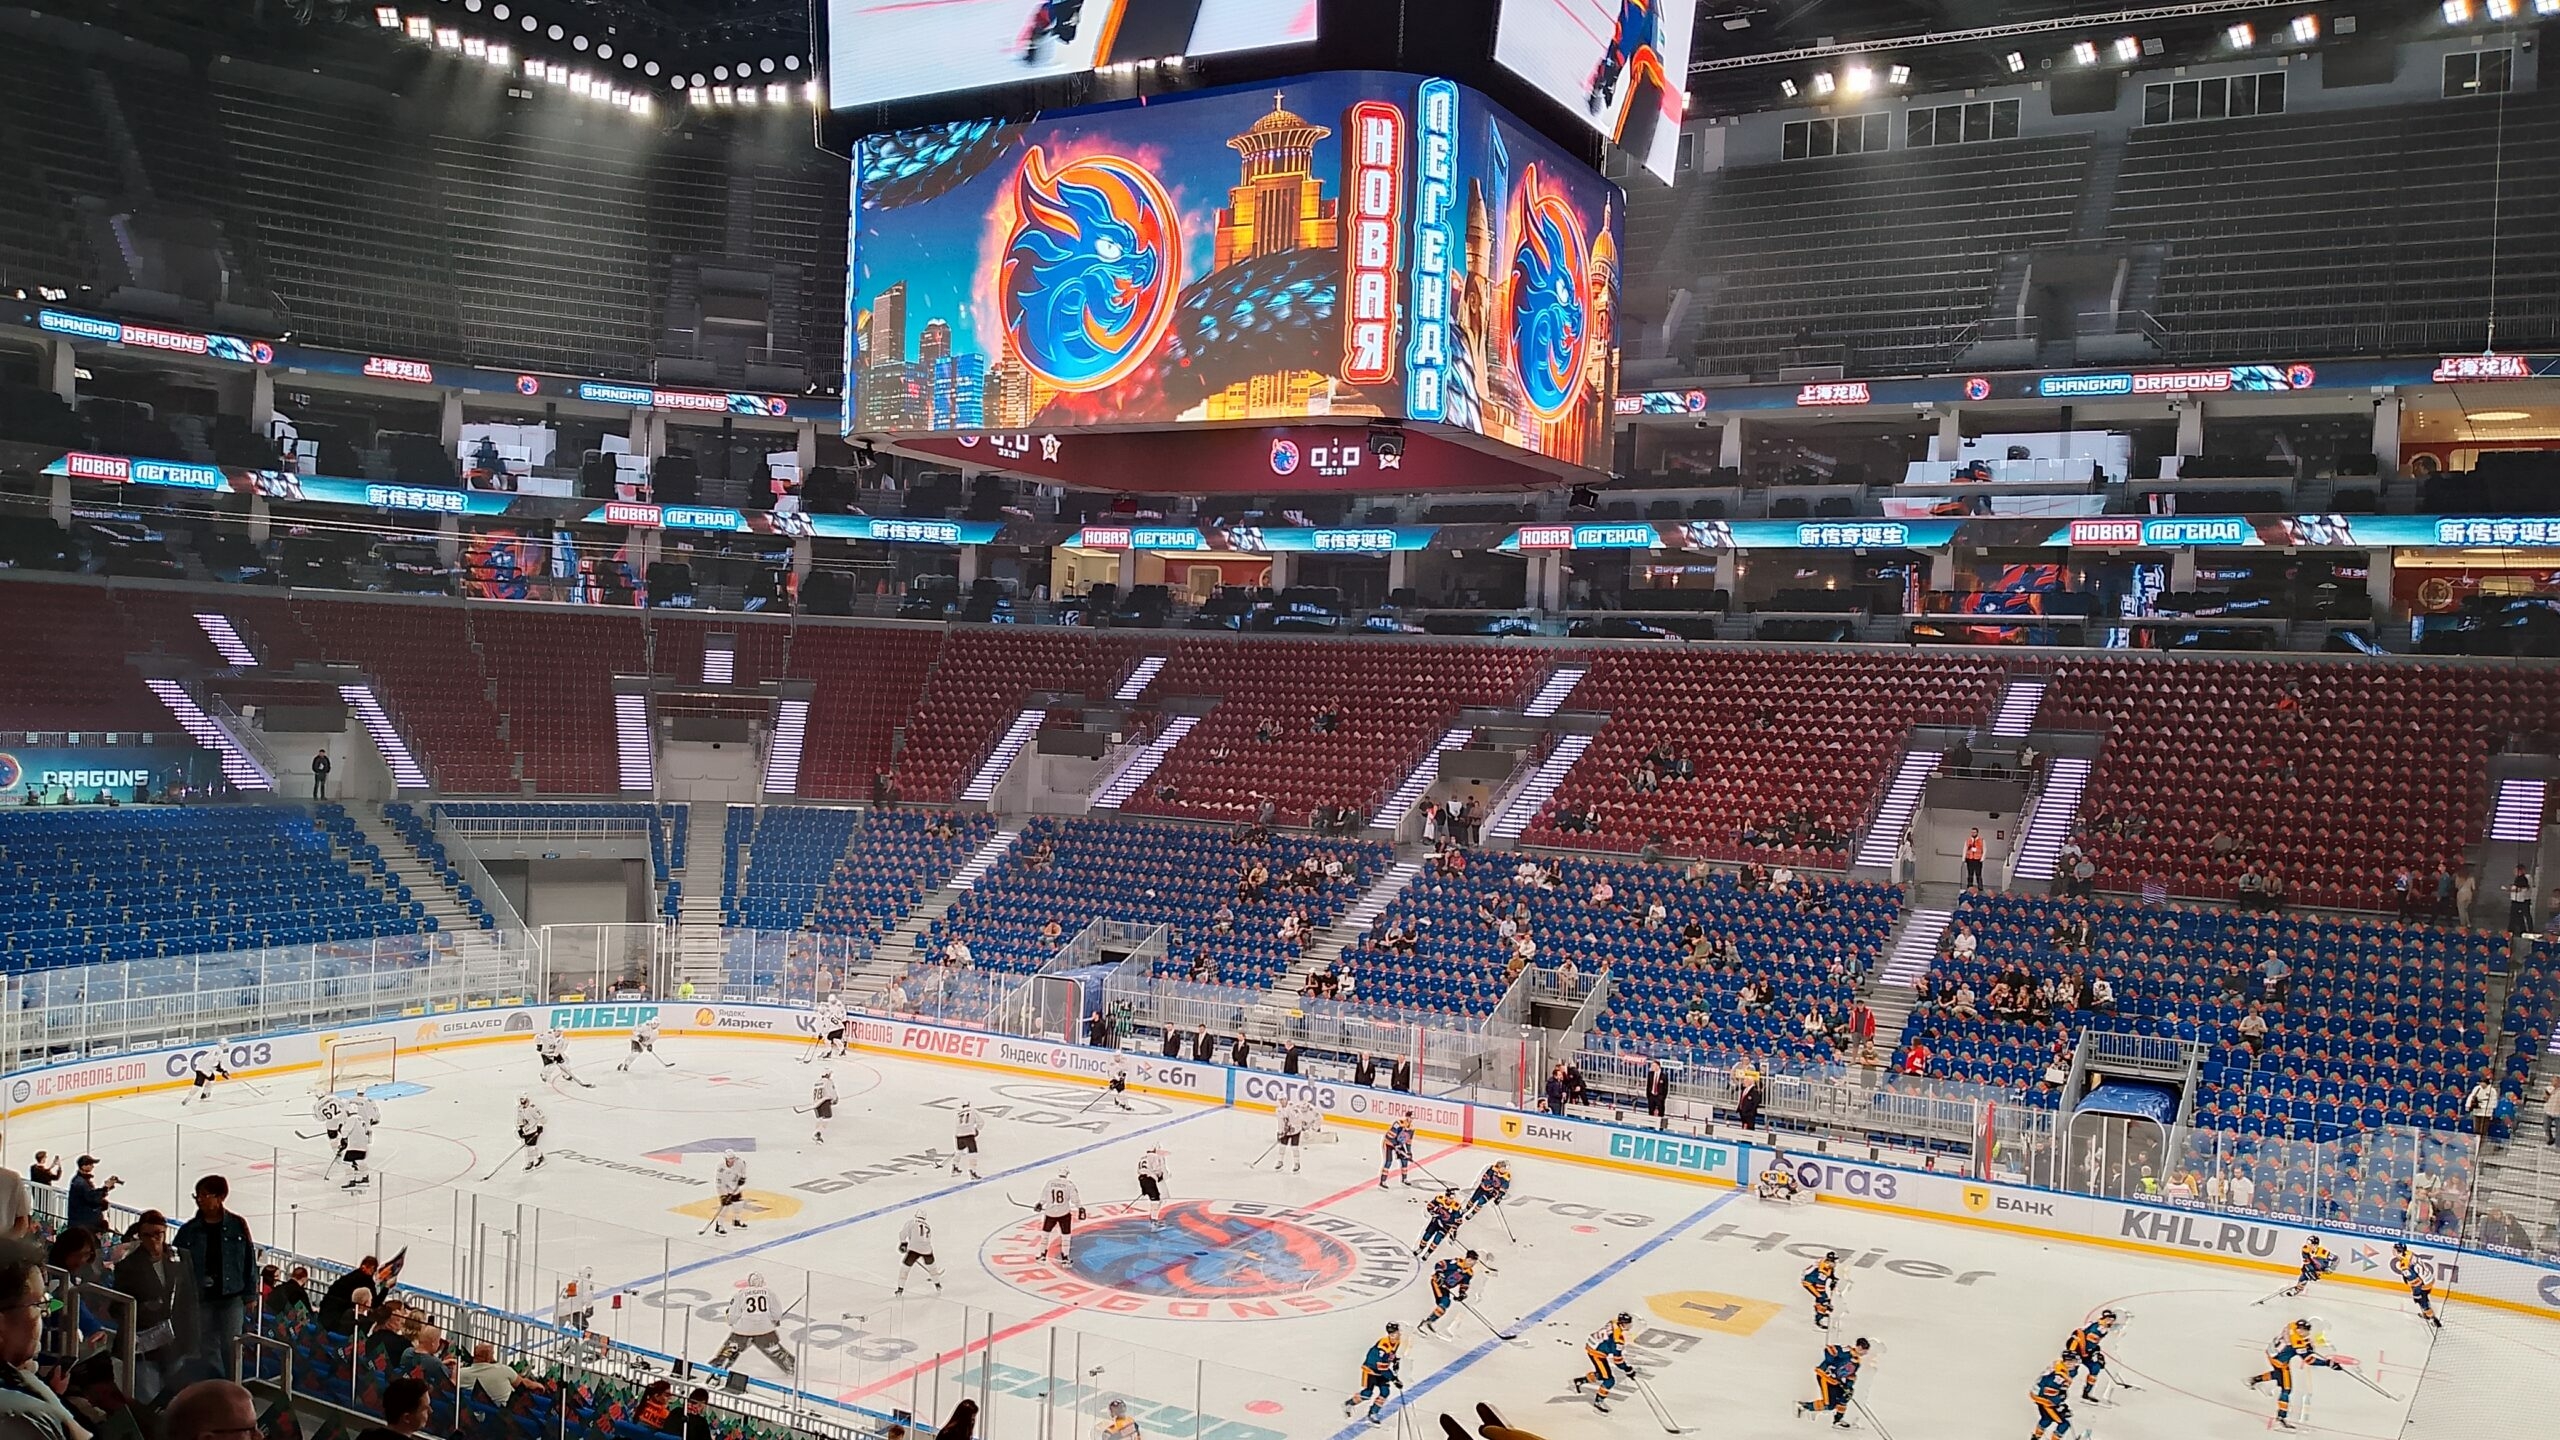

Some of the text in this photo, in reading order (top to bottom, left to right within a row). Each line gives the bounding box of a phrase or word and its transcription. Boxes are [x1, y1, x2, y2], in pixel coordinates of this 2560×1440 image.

[1351, 117, 1393, 372] НОВАЯ
[1417, 91, 1450, 411] ЛЕГЕНДА
[43, 315, 205, 351] SHANGHAI DRAGONS
[366, 357, 430, 379] 上海龙队
[2442, 357, 2523, 377] 上海龙队
[1802, 384, 1868, 401] 上海龙队
[2044, 374, 2229, 394] SHANGHAI DRAGONS
[583, 387, 726, 410] SHANGHAI DRAGONS
[1311, 446, 1360, 467] 0:0
[72, 457, 216, 485] НОВАЯ ЛЕГЕНДА
[368, 487, 466, 511] 新传奇诞生
[608, 507, 735, 528] НОВАЯ ЛЕГЕНДА
[872, 522, 958, 542] 新传奇诞生
[1084, 530, 1196, 547] НОВАЯ ЛЕГЕНДА
[1315, 532, 1392, 549] 新传奇诞生
[1521, 528, 1648, 545] НОВАЯ ЛЕГЕНДА
[1800, 525, 1904, 545] 新传奇诞生
[2074, 521, 2241, 541] НОВАЯ ЛЕГЕНДА
[43, 770, 149, 788] DRAGONS
[549, 1006, 658, 1029] СИБУР
[718, 1009, 747, 1018] Яндекс
[718, 1017, 774, 1030] Маркет
[796, 1014, 816, 1033] VK
[443, 1019, 502, 1033] GISLAVED
[902, 1027, 990, 1058] FONBET
[166, 1042, 273, 1078] соаз
[1000, 1042, 1106, 1074] Яндекс Плюс
[1158, 1067, 1197, 1088] сбп
[322, 1103, 341, 1120] 62
[1526, 1124, 1573, 1143] БАНК
[1609, 1132, 1728, 1172] СИБУР
[548, 1148, 708, 1187] Ростелеком
[1051, 1189, 1065, 1204] 18
[1996, 1195, 2054, 1217] БАНК
[919, 1224, 931, 1238] 17
[2120, 1208, 2279, 1257] KHL.RU
[1700, 1223, 1997, 1287] Haier
[746, 1295, 767, 1313] 30
